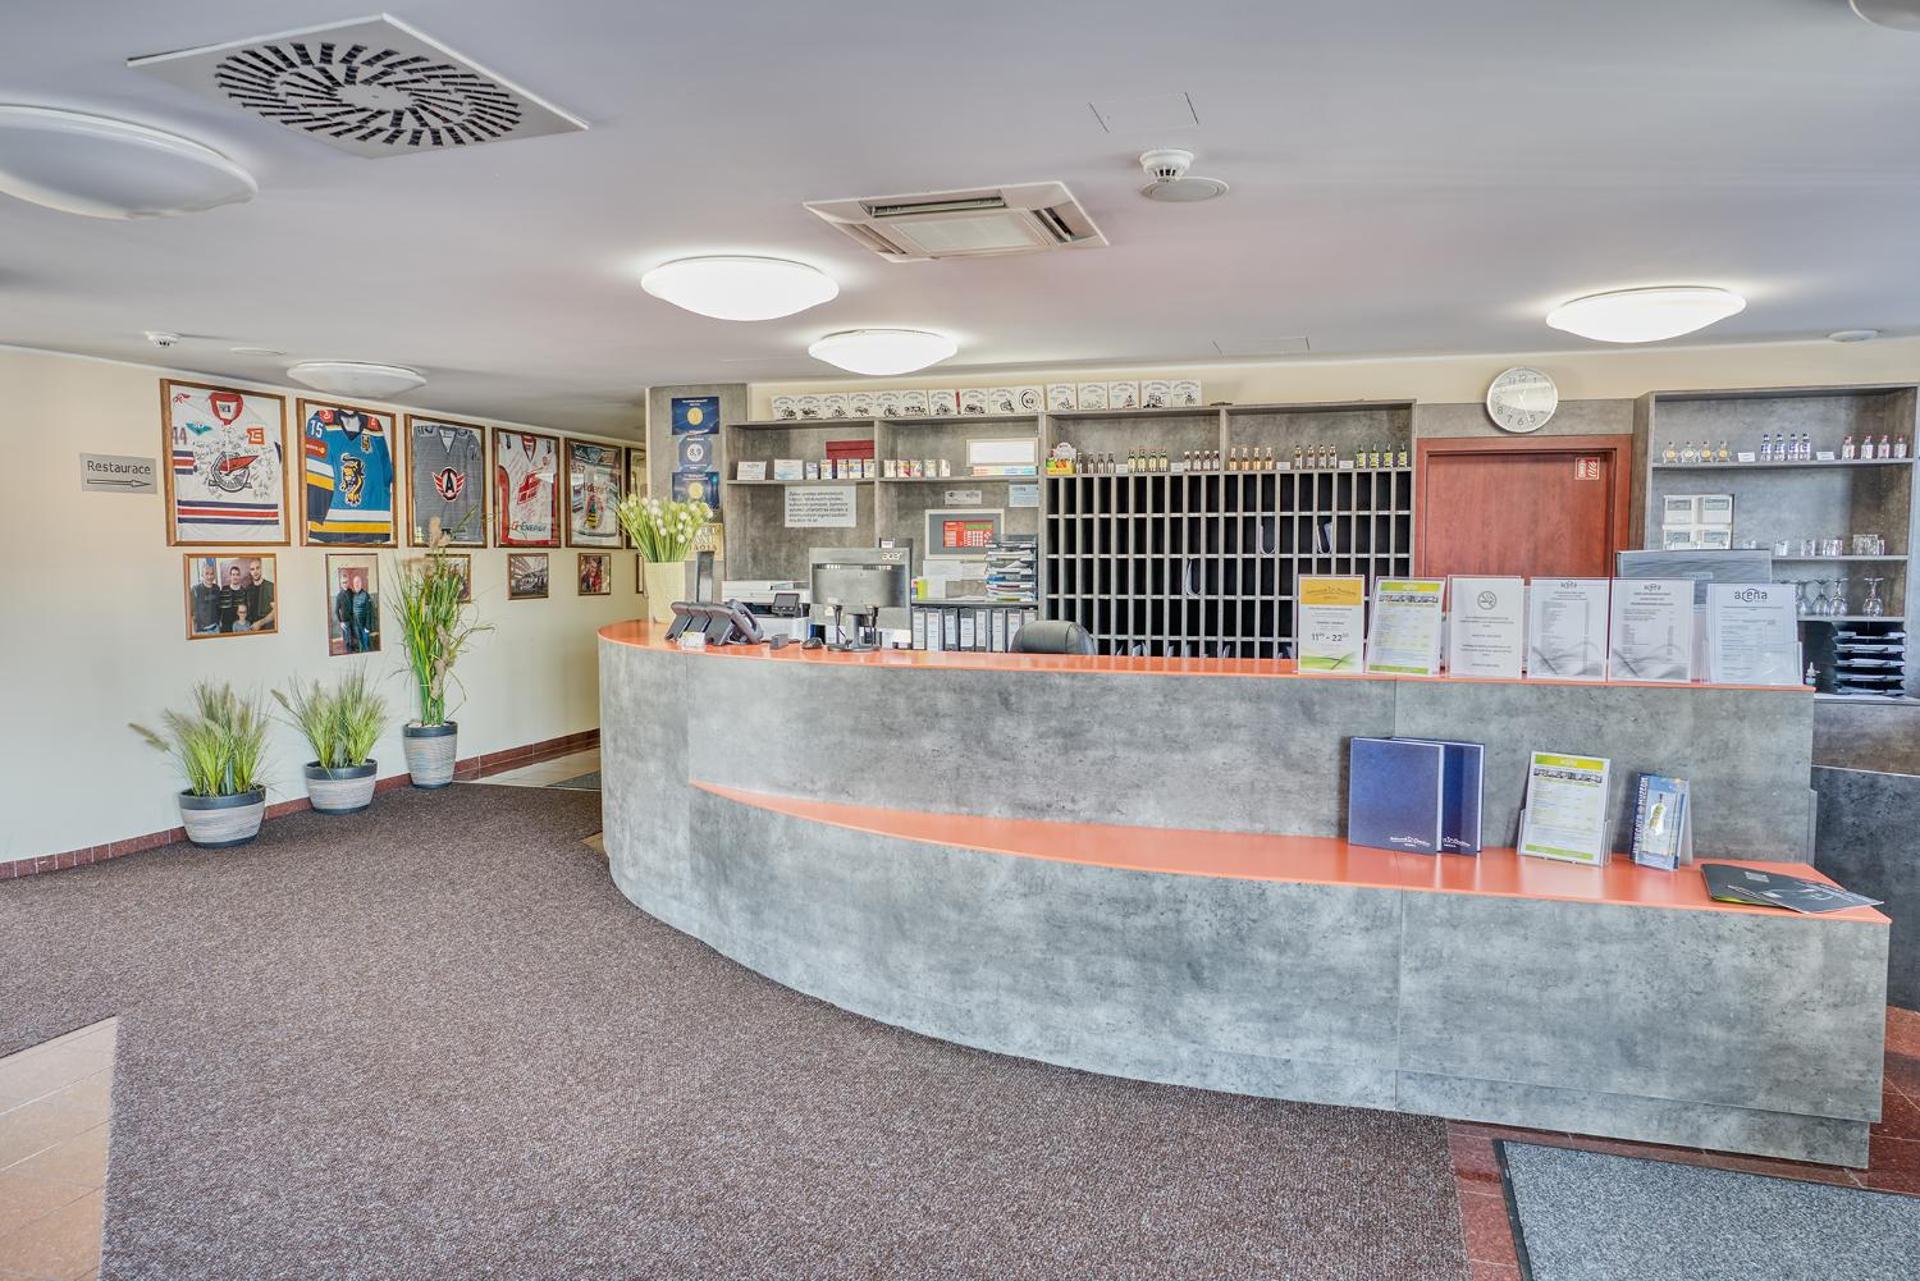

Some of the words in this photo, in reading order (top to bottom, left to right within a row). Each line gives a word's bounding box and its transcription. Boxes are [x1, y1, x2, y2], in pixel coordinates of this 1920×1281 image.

[311, 419, 324, 439] 15
[87, 460, 151, 475] Restaurace
[1734, 589, 1768, 601] arena
